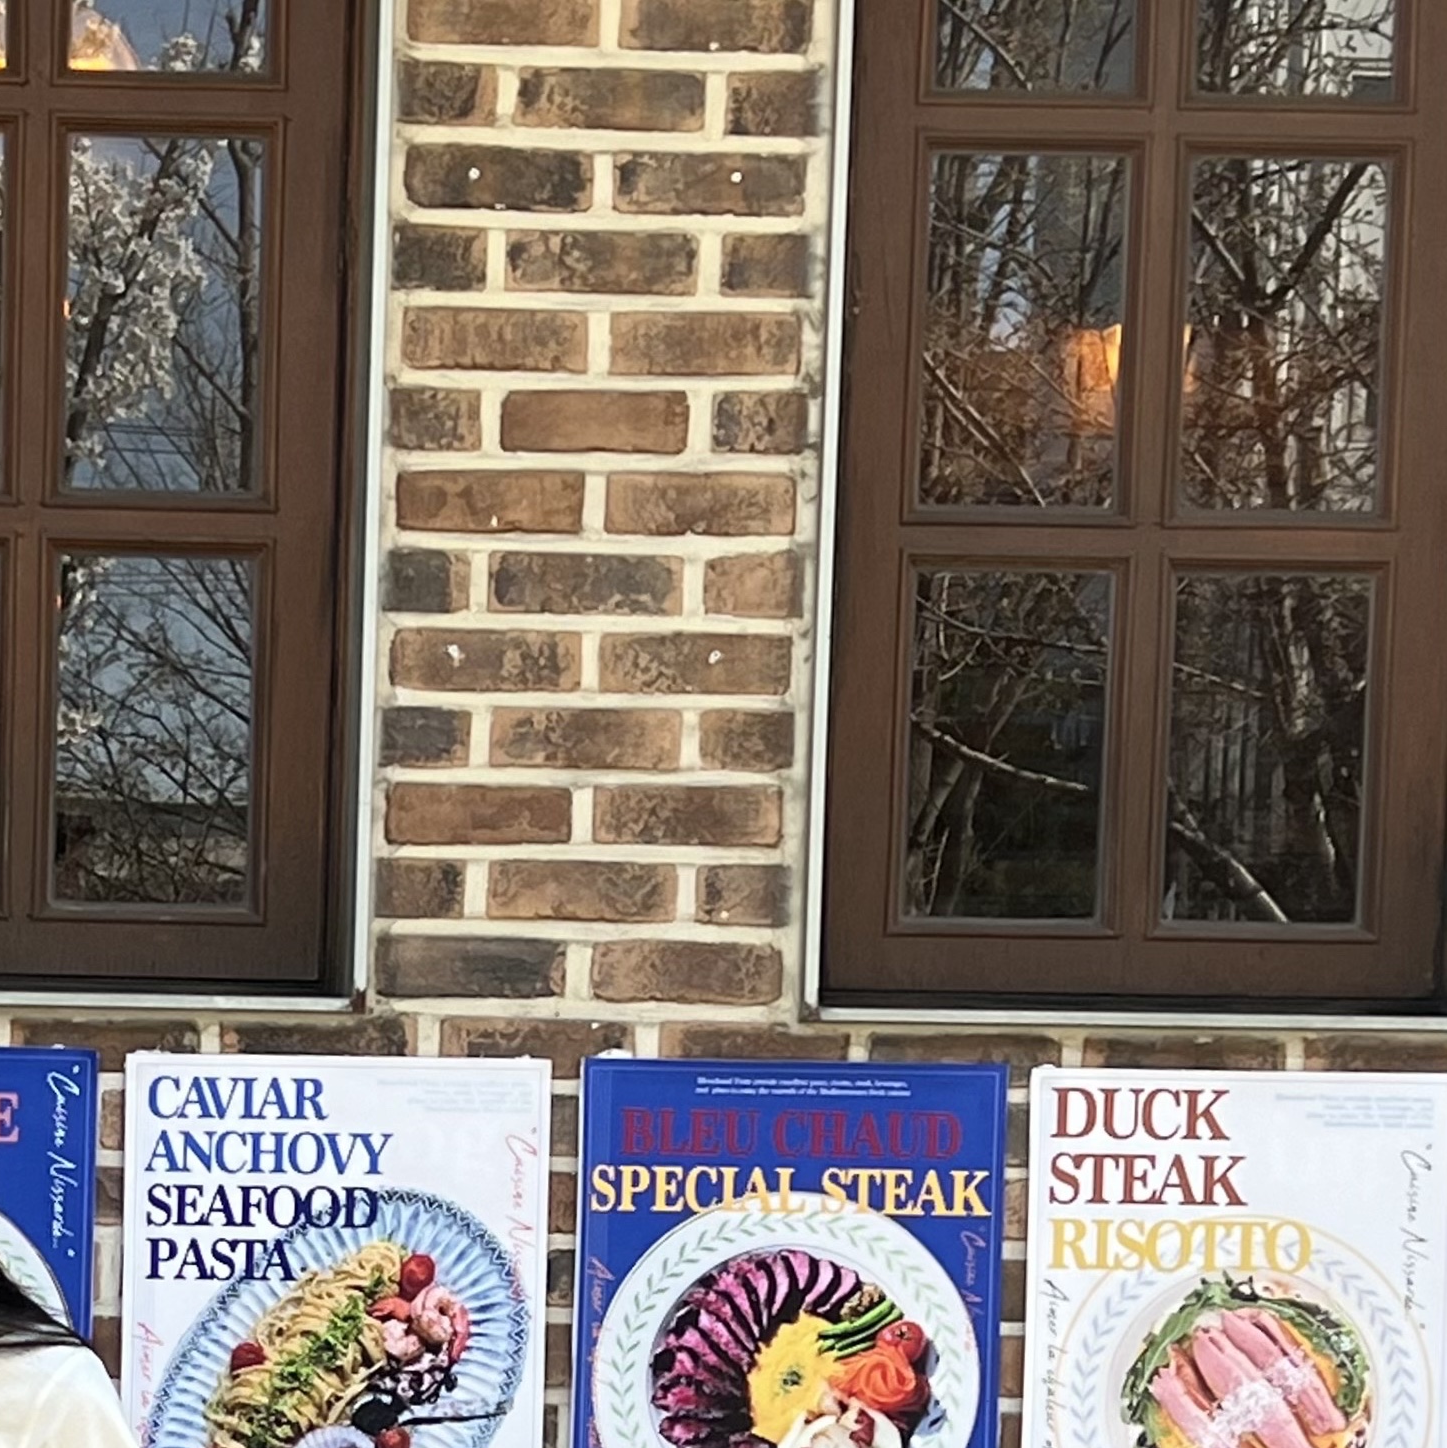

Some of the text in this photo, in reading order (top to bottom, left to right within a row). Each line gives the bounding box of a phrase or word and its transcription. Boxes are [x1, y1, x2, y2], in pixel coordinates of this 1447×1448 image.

[148, 1075, 329, 1121] CAVIAR
[1049, 1086, 1231, 1142] DUCK
[144, 1129, 393, 1176] ANCHOVY
[620, 1106, 963, 1160] BLEU CHAUD
[145, 1183, 379, 1229] SEAFOOD
[589, 1163, 992, 1217] SPECIAL STEAK
[1049, 1151, 1249, 1207] STEAK
[145, 1237, 299, 1282] PASTA
[1047, 1217, 1313, 1275] RISOTTO
